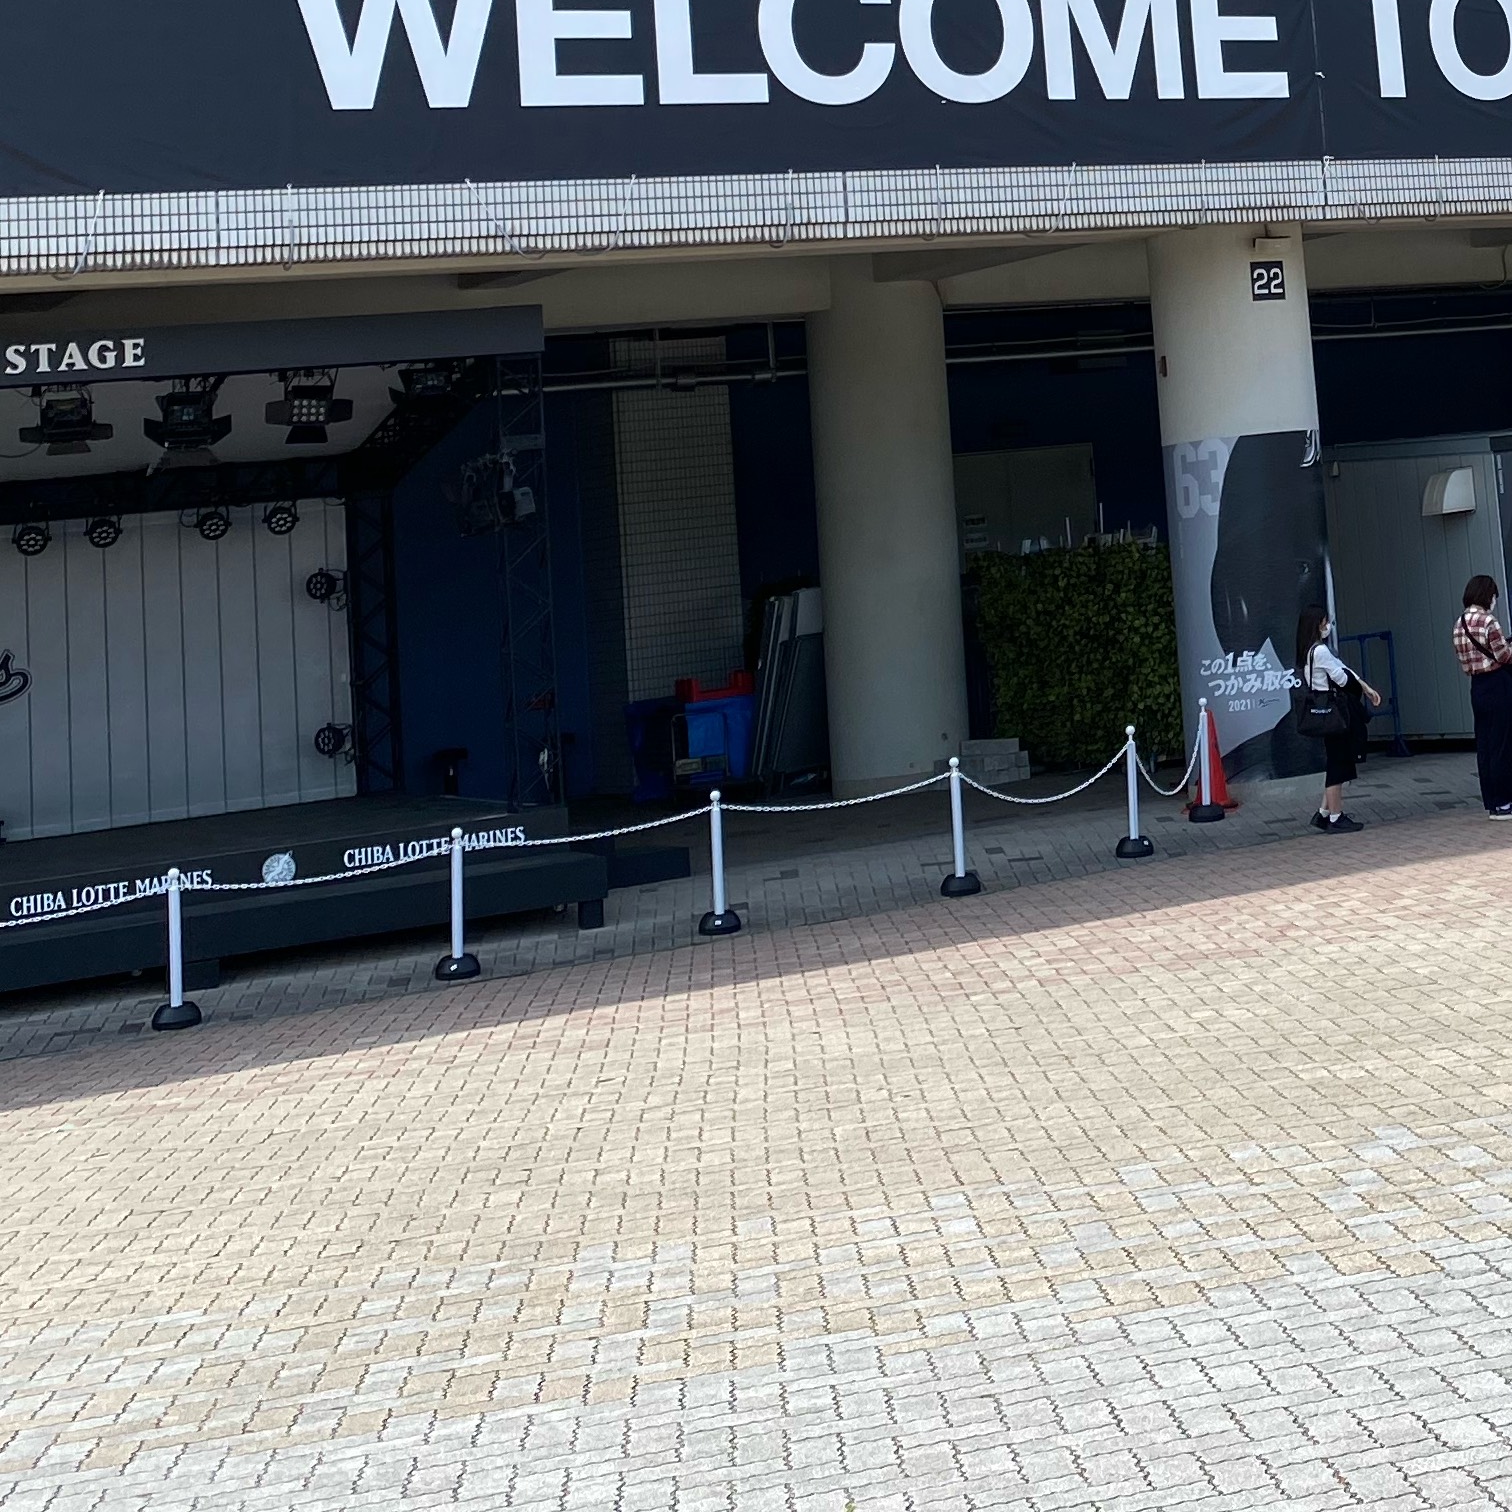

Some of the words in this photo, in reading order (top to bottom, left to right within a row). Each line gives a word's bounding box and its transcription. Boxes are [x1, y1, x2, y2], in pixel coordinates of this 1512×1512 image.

[1253, 267, 1284, 295] 22
[5, 338, 146, 375] STAGE
[1173, 439, 1229, 519] 63
[1200, 650, 1272, 676] この1点を、
[1208, 668, 1302, 697] つかみ取る。
[1228, 699, 1251, 712] 2021
[343, 843, 394, 868] CHIBA
[399, 836, 450, 862] LOTTE
[10, 890, 67, 917] CHIBA
[72, 881, 129, 908] LOTTE
[135, 869, 214, 895] MARNES
